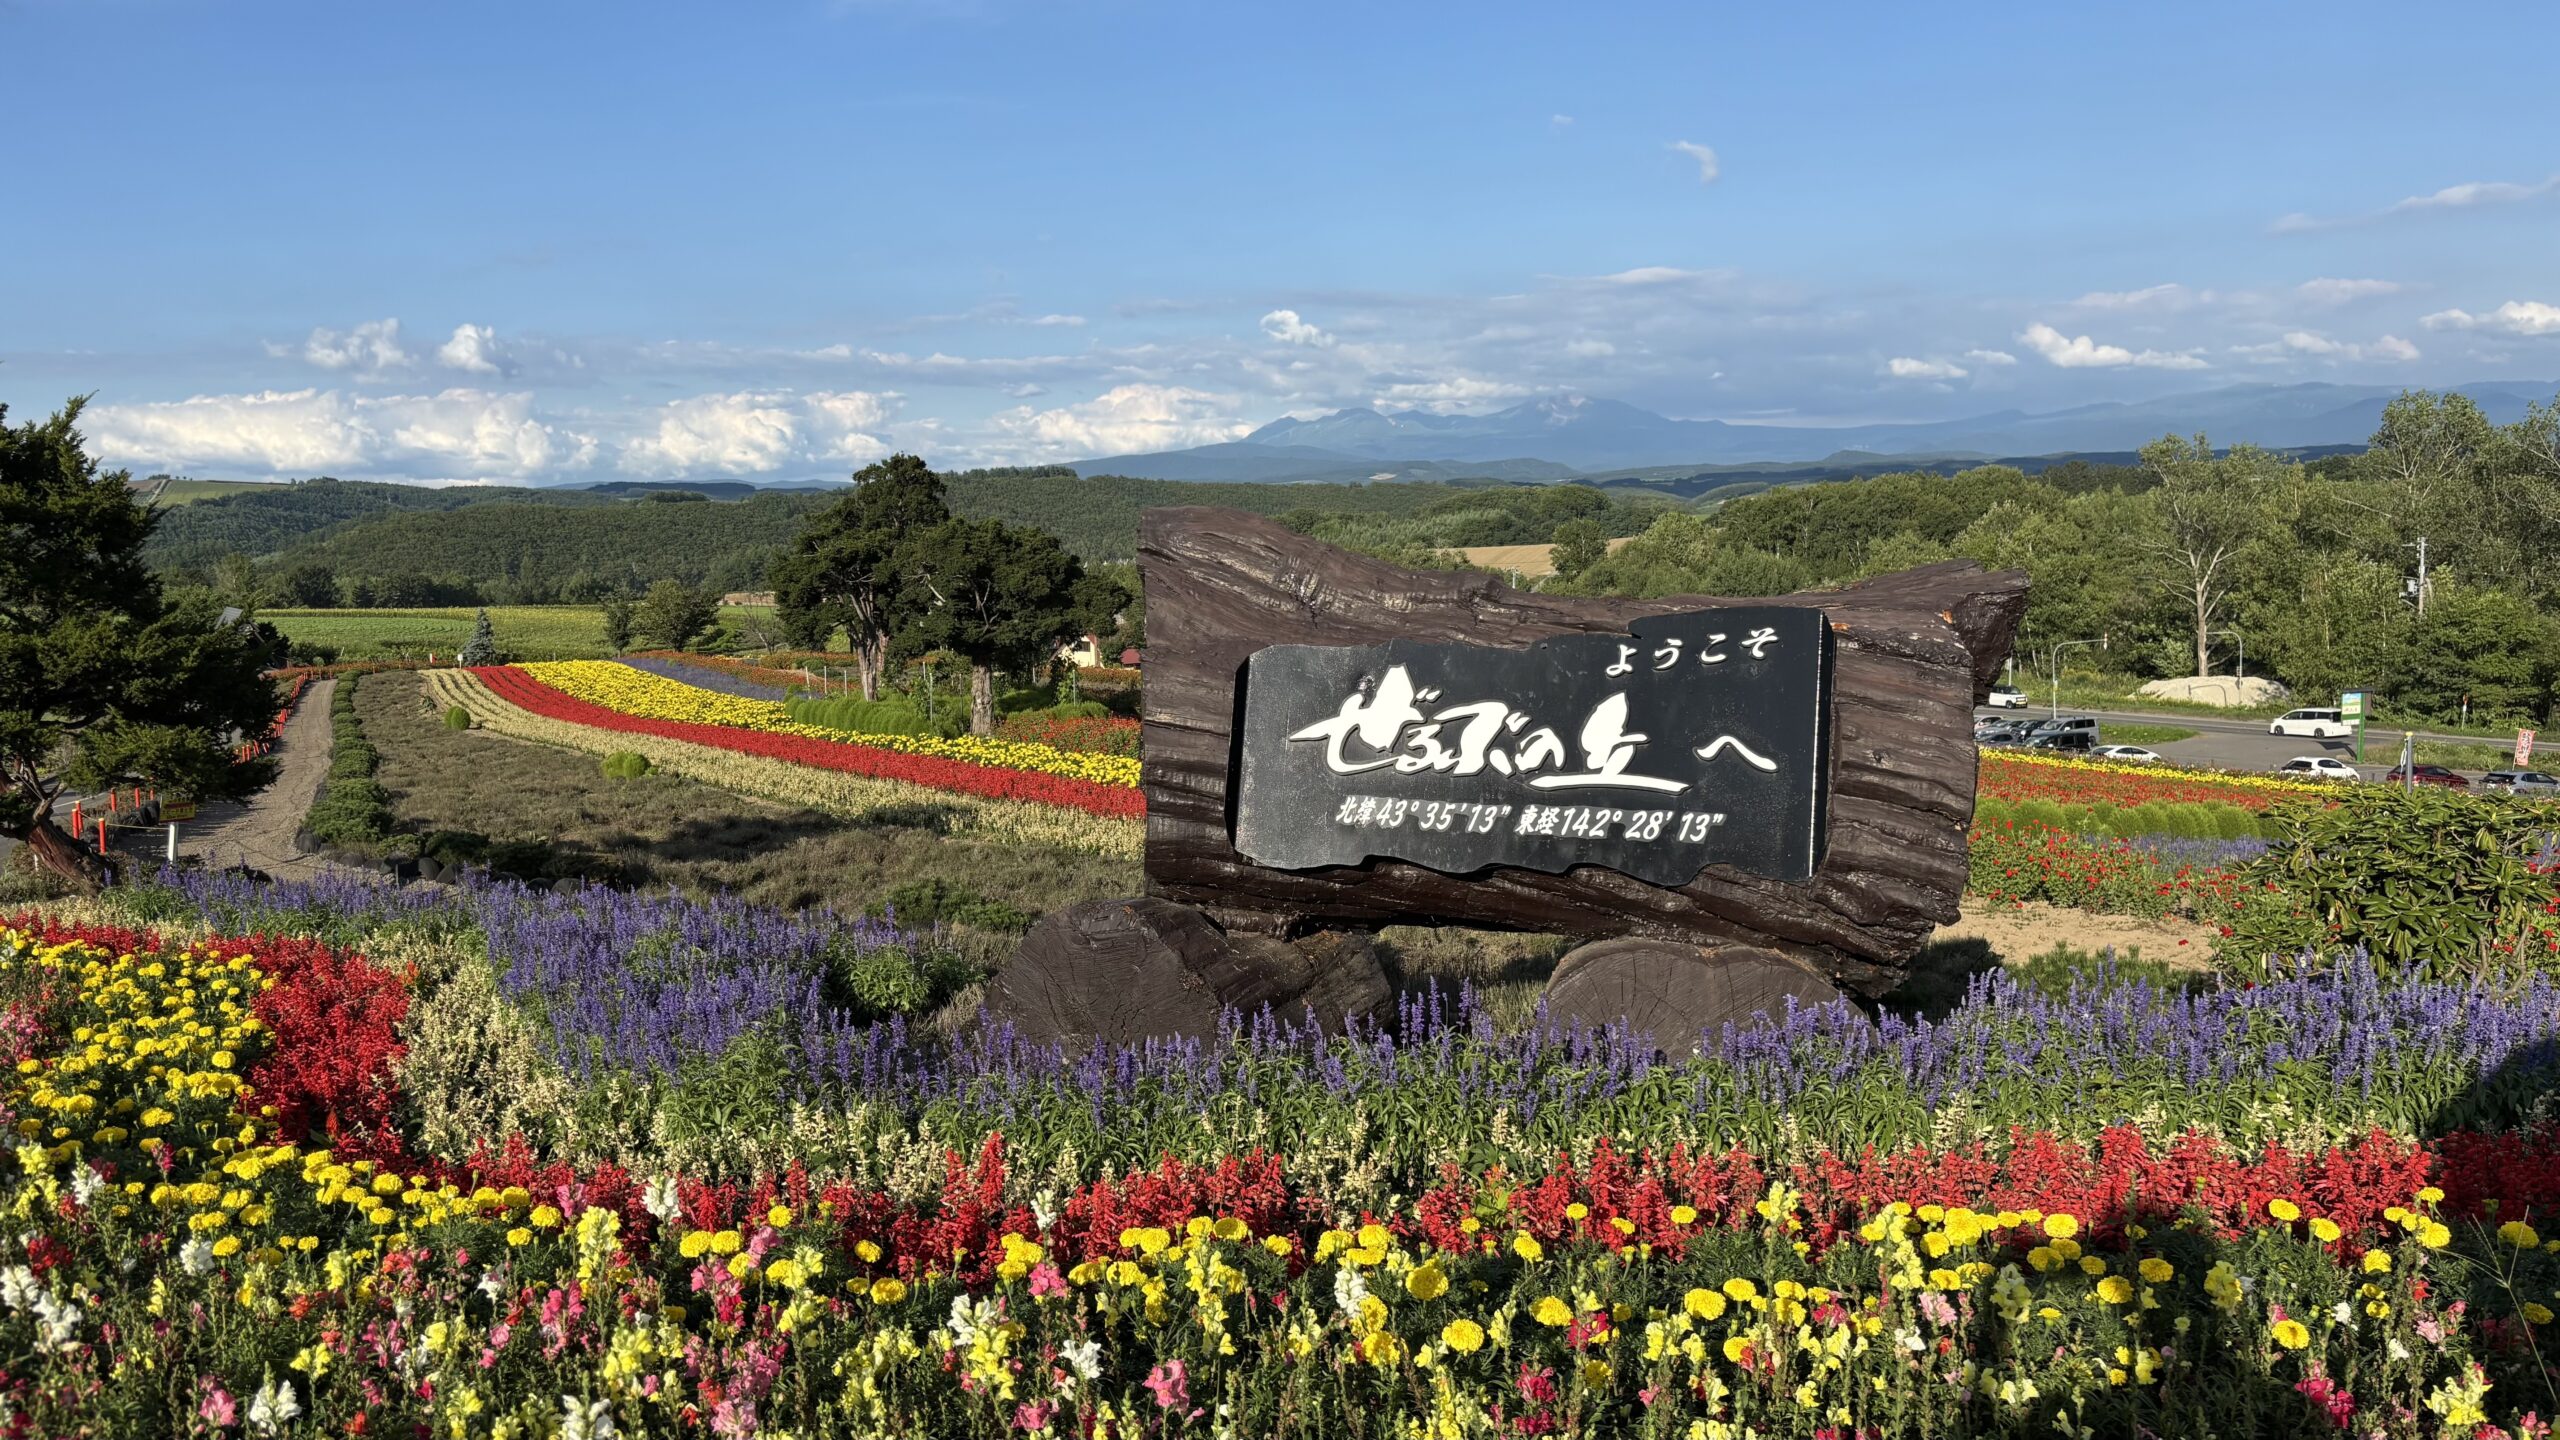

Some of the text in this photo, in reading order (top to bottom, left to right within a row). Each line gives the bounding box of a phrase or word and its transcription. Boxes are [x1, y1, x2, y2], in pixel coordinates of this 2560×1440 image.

[1606, 627, 1778, 676] ようこそ
[1289, 664, 1777, 792] ぜるぶの丘 へ
